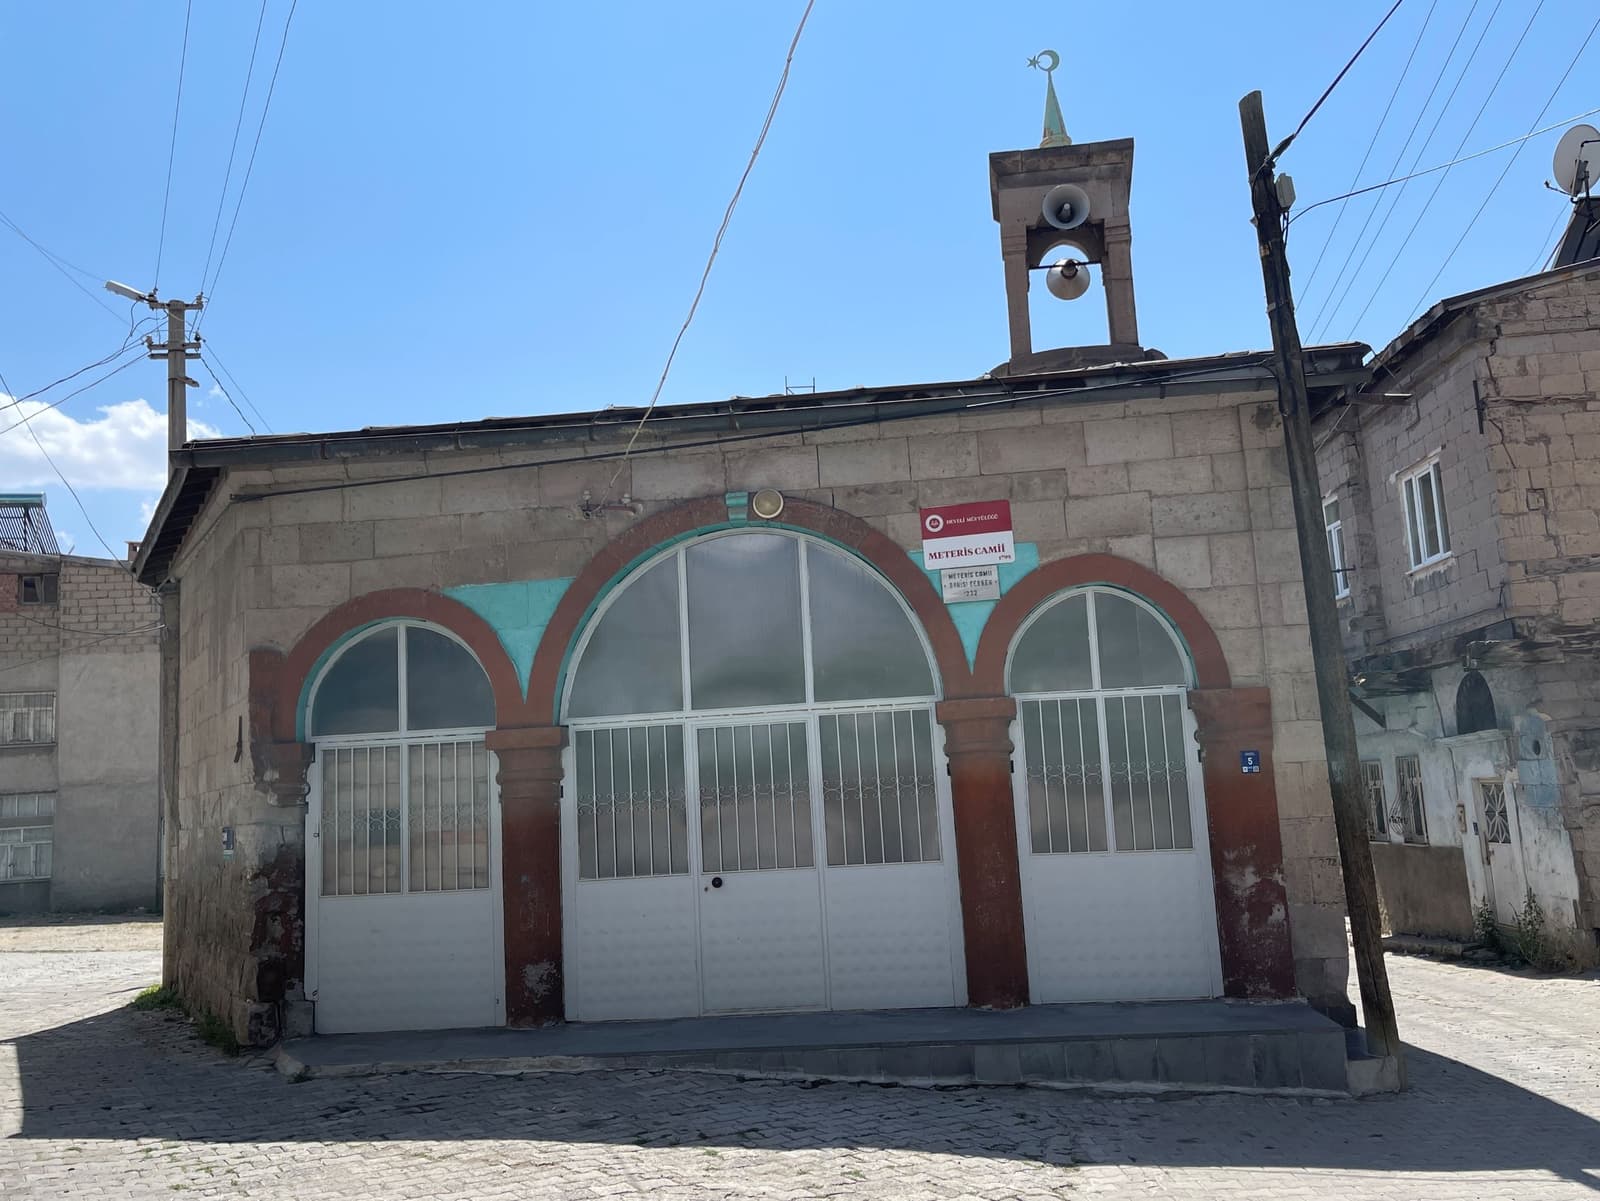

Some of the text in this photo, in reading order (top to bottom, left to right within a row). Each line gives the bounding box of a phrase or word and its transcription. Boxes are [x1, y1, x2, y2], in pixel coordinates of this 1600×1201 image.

[928, 543, 1005, 560] METERİS CAMİİ
[1247, 757, 1253, 766] 5
